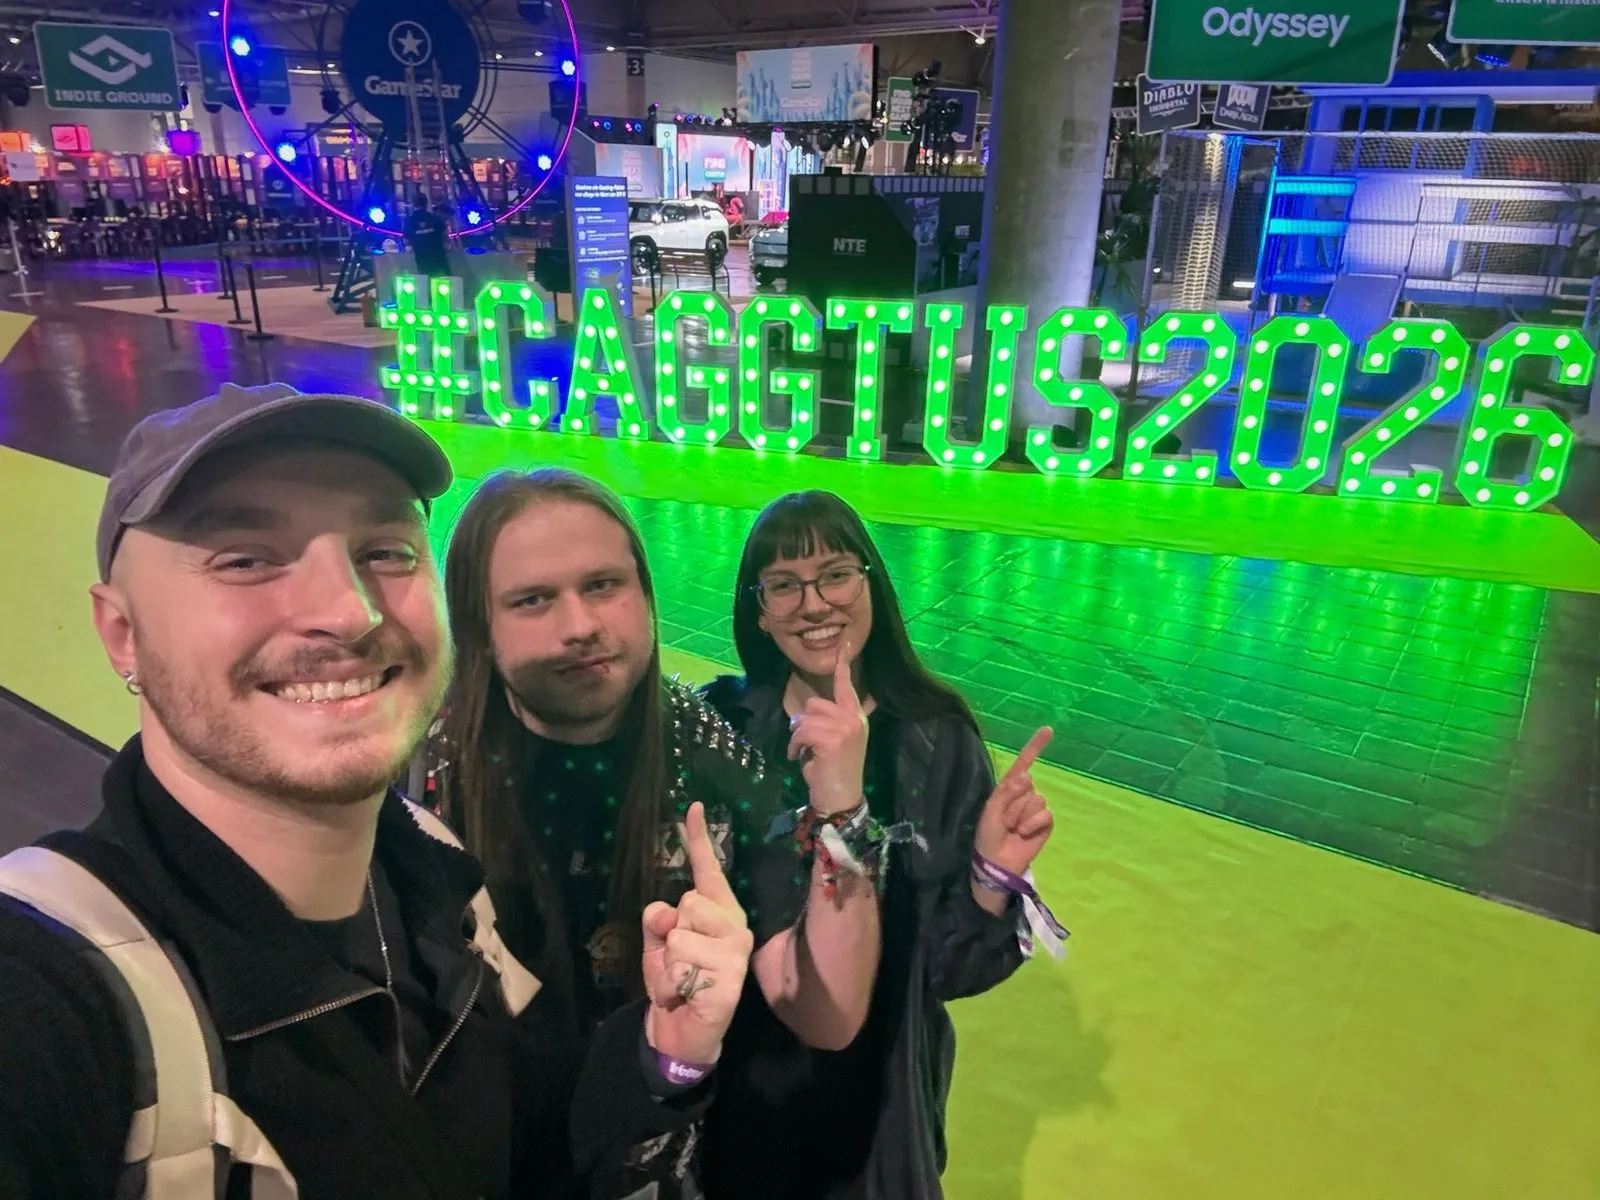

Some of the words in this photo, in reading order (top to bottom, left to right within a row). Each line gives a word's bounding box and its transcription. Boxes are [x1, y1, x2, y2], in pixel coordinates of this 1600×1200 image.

[1202, 6, 1350, 47] Odyssey
[632, 60, 640, 74] 3
[55, 89, 103, 103] INDIE
[105, 91, 174, 104] GROUND
[1143, 83, 1195, 105] DIABLO
[833, 238, 867, 252] NTE
[379, 276, 1596, 511] #CAGGTUS2026
